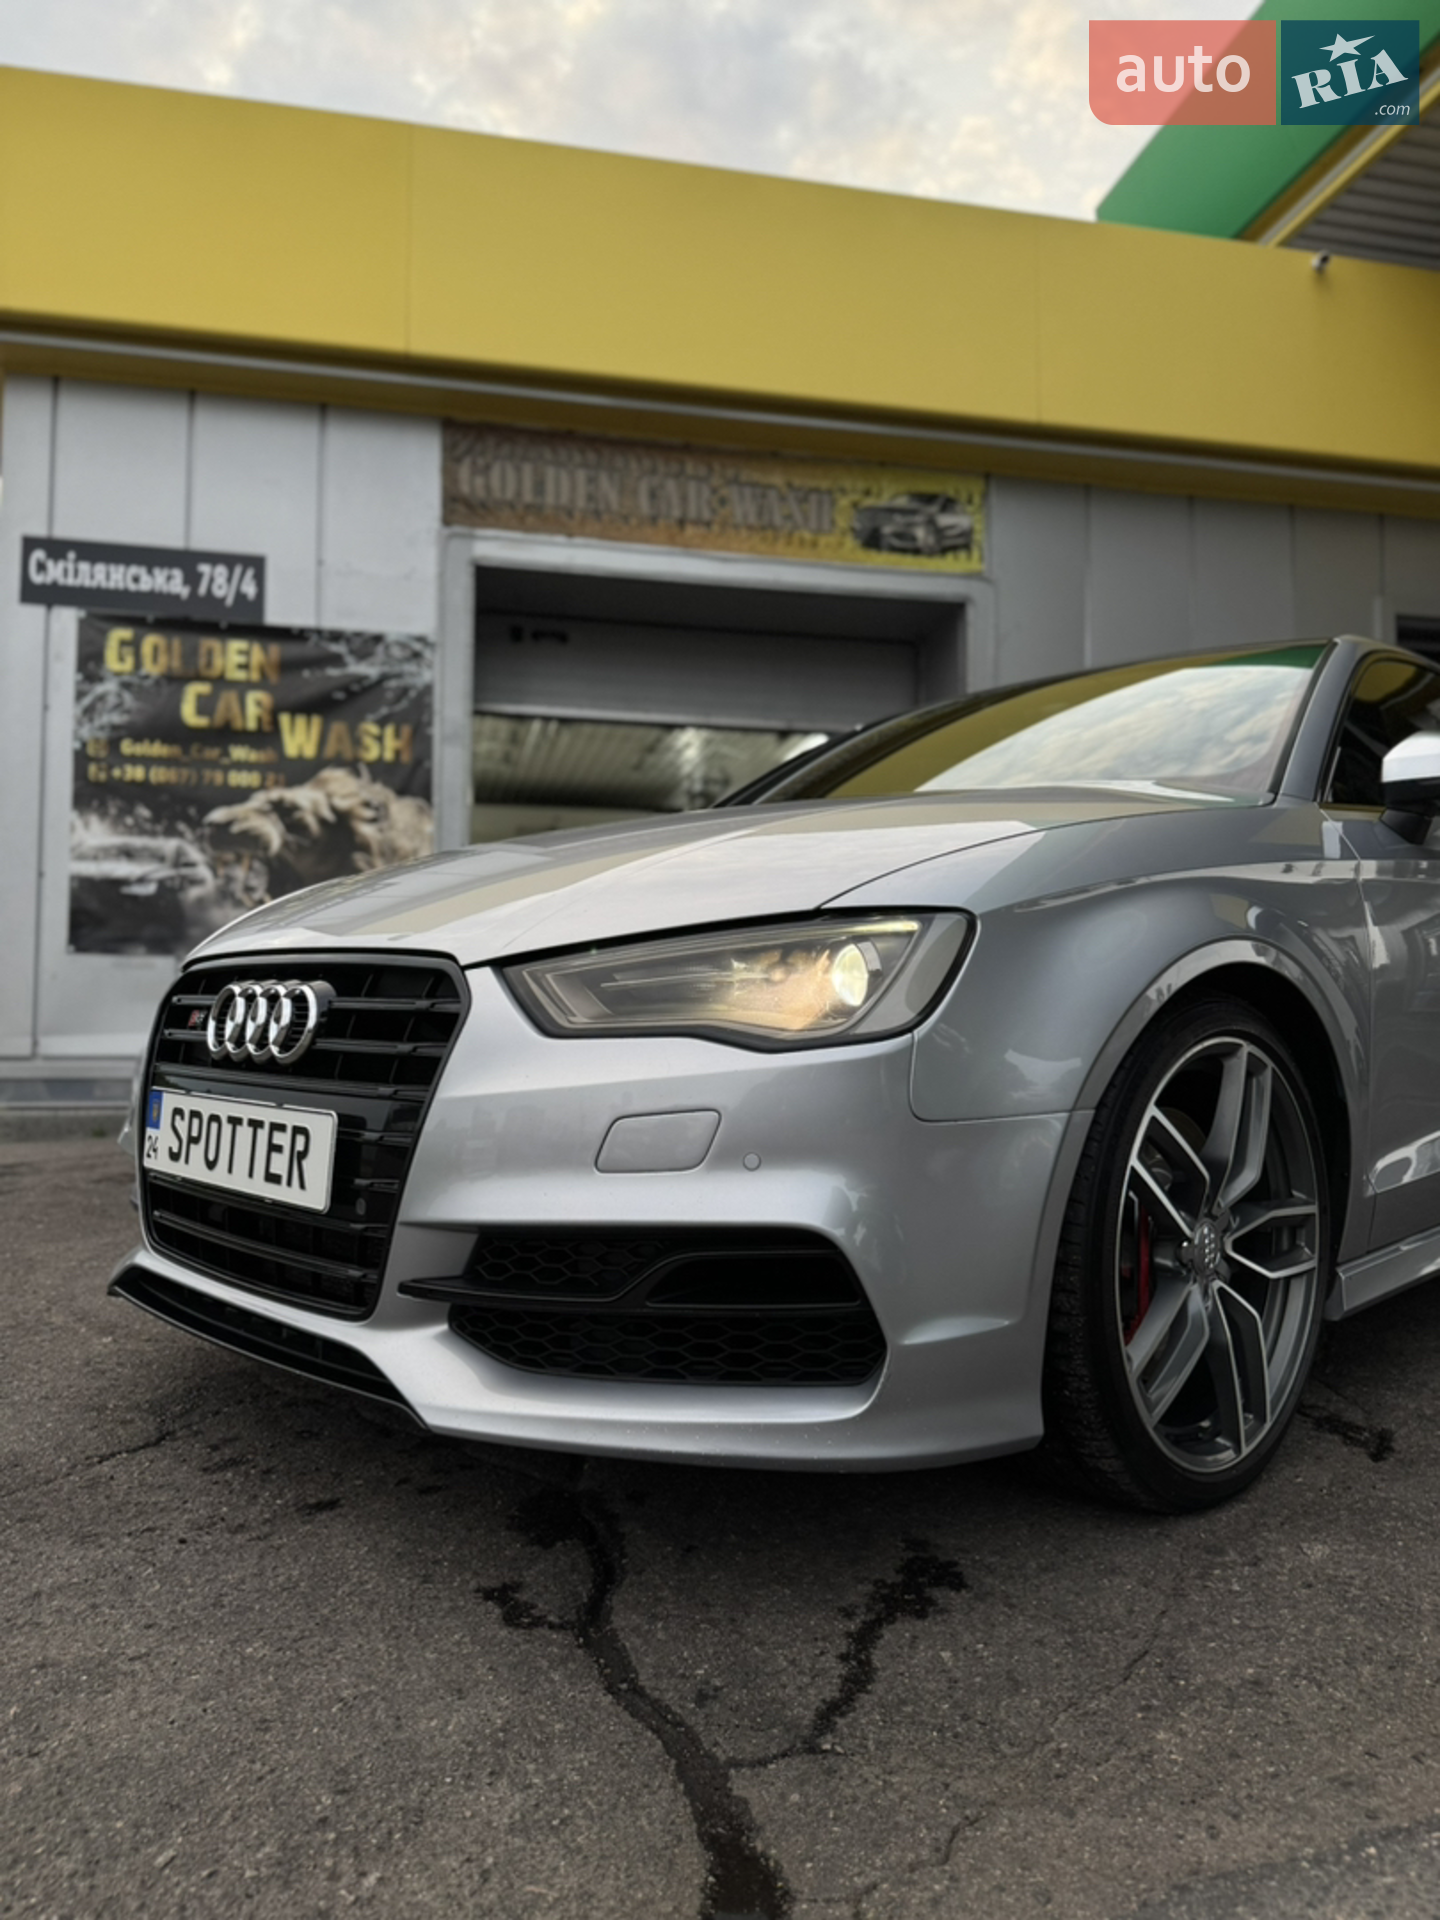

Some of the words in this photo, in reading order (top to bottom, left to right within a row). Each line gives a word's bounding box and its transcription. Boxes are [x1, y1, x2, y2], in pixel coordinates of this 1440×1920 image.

[457, 455, 621, 511] GOLDEN
[638, 474, 714, 522] CAR
[729, 483, 834, 532] WASH
[28, 548, 190, 600] Смілянська,
[197, 562, 258, 607] 78/4
[103, 627, 281, 684] GOLDEN
[180, 681, 274, 732] CAR
[278, 711, 413, 764] WASH
[146, 1135, 159, 1160] 24
[168, 1107, 310, 1191] SPOTTER
